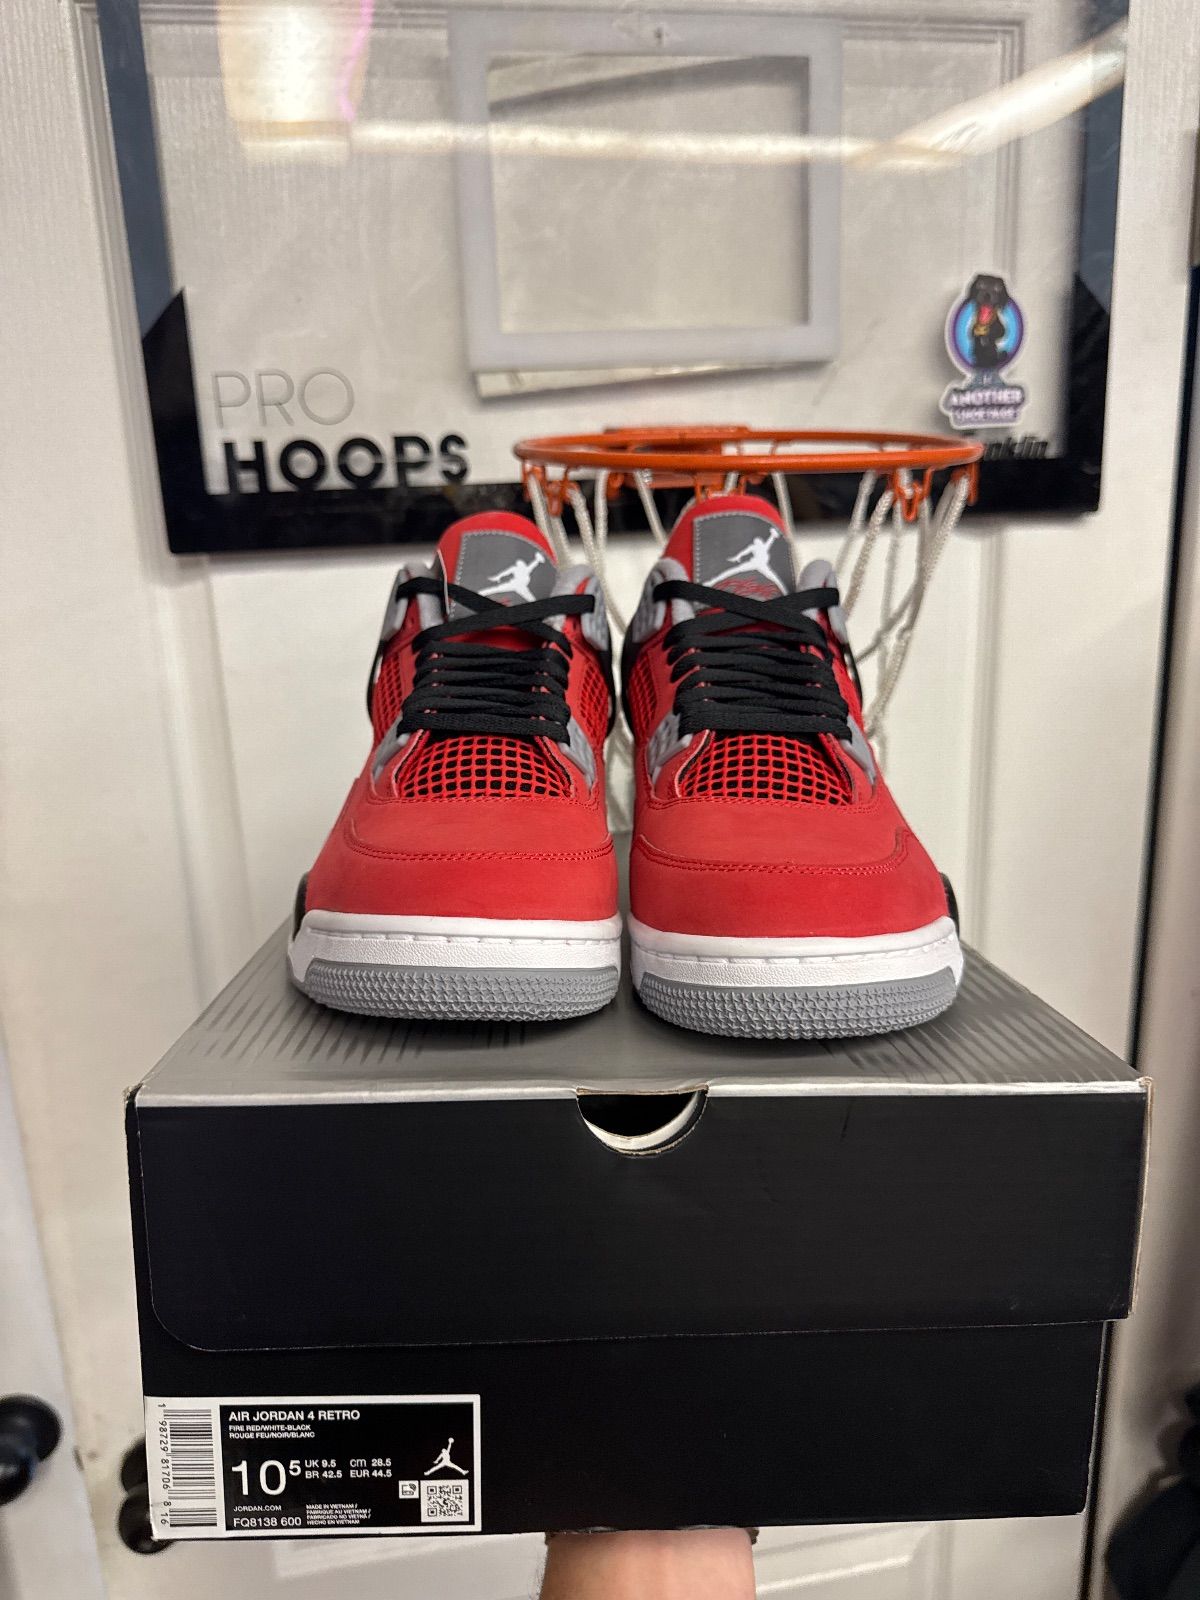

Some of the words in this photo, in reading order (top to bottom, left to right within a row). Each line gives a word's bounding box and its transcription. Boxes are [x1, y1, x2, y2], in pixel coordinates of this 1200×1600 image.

[212, 367, 355, 428] PRO
[223, 434, 468, 492] HOOPS
[228, 1411, 250, 1421] AIR
[252, 1410, 305, 1421] JORDAN
[307, 1410, 315, 1420] 4
[318, 1410, 361, 1420] RETRO
[256, 1431, 316, 1439] FEU/NOIR/BLANC
[305, 1459, 319, 1468] UK
[322, 1459, 337, 1468] 9.5
[350, 1459, 367, 1468] cm
[371, 1458, 392, 1467] 28.5
[161, 1458, 171, 1490] 81706
[231, 1460, 287, 1496] 10
[305, 1470, 319, 1479] BR
[322, 1470, 343, 1479] 42.5
[350, 1470, 370, 1478] EUR
[372, 1469, 393, 1478] 44.5
[233, 1517, 278, 1527] FQ8138
[280, 1516, 302, 1527] 600
